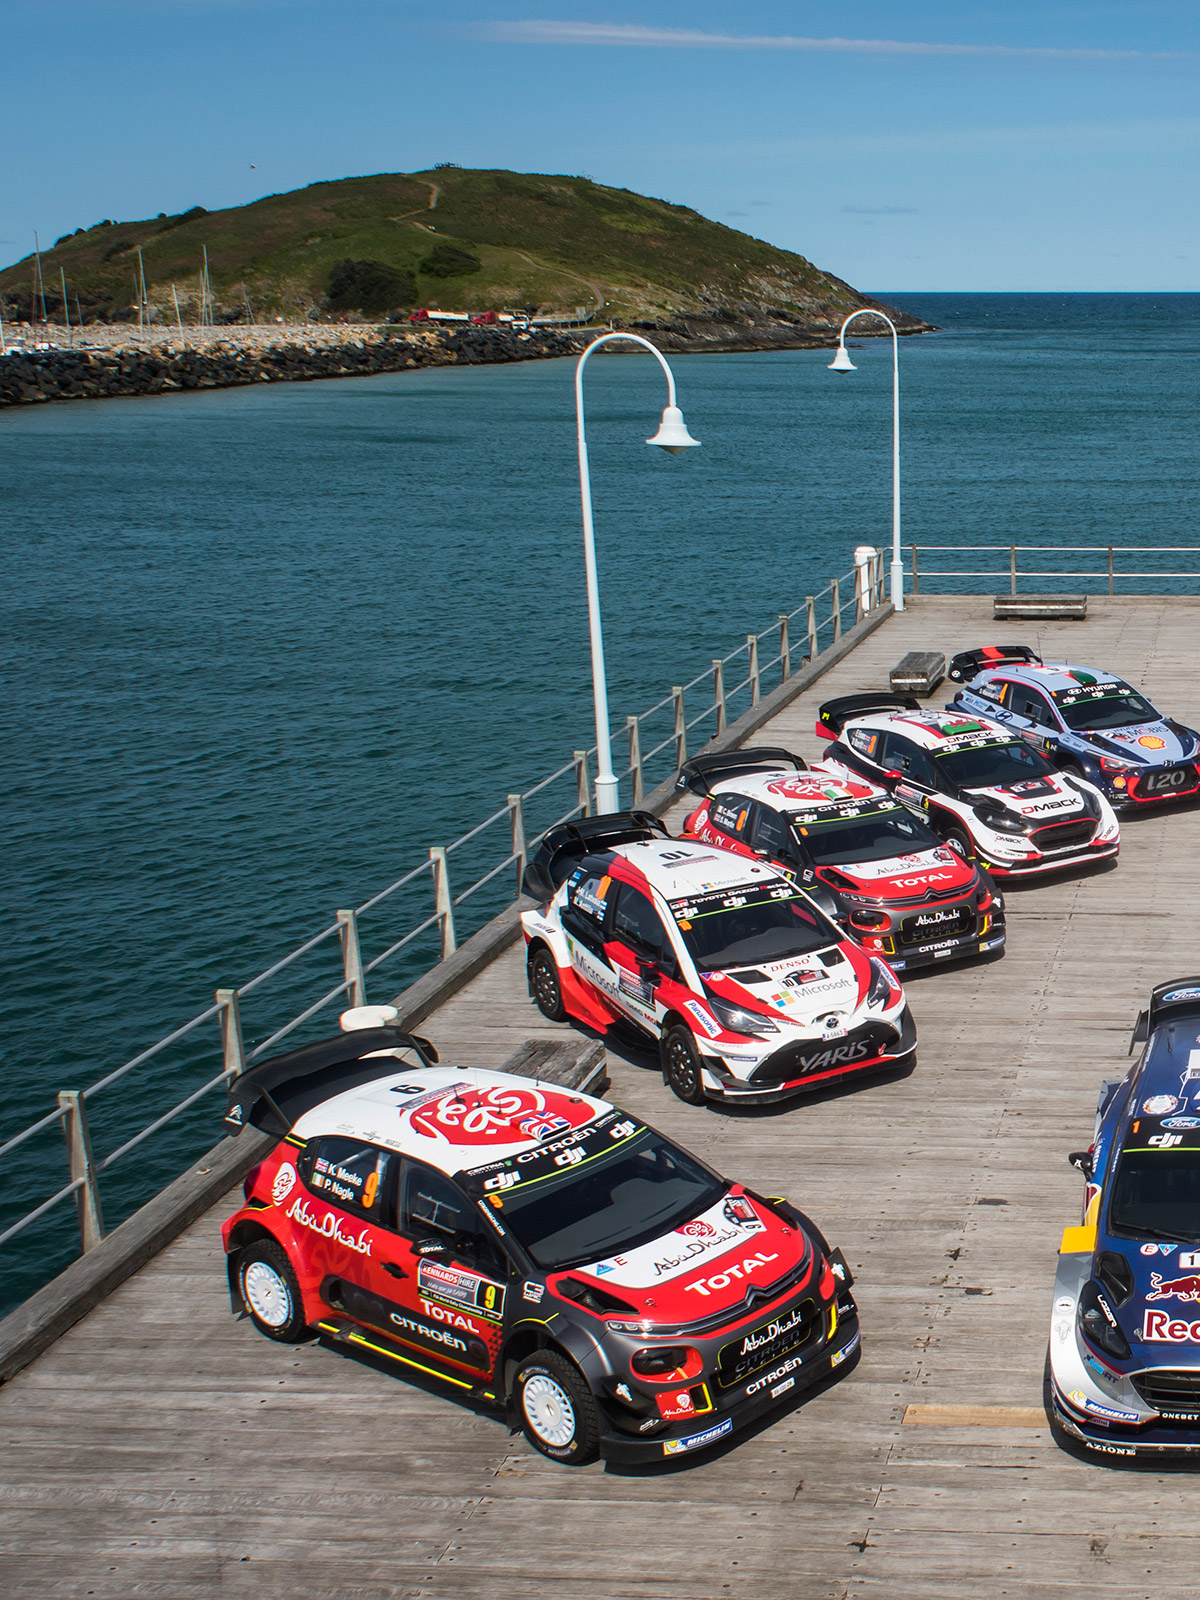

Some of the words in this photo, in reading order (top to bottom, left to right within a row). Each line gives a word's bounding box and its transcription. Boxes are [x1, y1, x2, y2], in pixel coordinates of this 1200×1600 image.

[1082, 683, 1117, 693] HYUNDAI
[890, 873, 953, 888] TOTAL
[692, 893, 727, 905] TOYOTA
[678, 920, 693, 932] 10
[771, 958, 811, 973] DENSO
[575, 950, 622, 998] Microsoft
[782, 978, 794, 988] 10
[794, 978, 853, 998] Microsoft
[688, 1002, 717, 1035] Panasonic
[1132, 1121, 1141, 1134] 1
[337, 1166, 363, 1187] Meeke
[331, 1182, 355, 1200] Nagle
[362, 1172, 379, 1209] 9
[488, 1194, 504, 1209] 9
[420, 1246, 446, 1254] TOTAL
[1145, 1246, 1155, 1254] E
[1188, 1254, 1196, 1266] 1
[422, 1264, 459, 1284] KENNARDS
[460, 1276, 476, 1291] HIRE
[684, 1252, 779, 1296] TOTAL
[485, 1286, 496, 1309] 9
[420, 1299, 480, 1334] TOTAL
[1088, 1403, 1138, 1421] MICHELIN
[1162, 1413, 1199, 1421] ONEBET
[686, 1422, 731, 1447] MICHELIN
[1086, 1442, 1137, 1456] AZIONE
